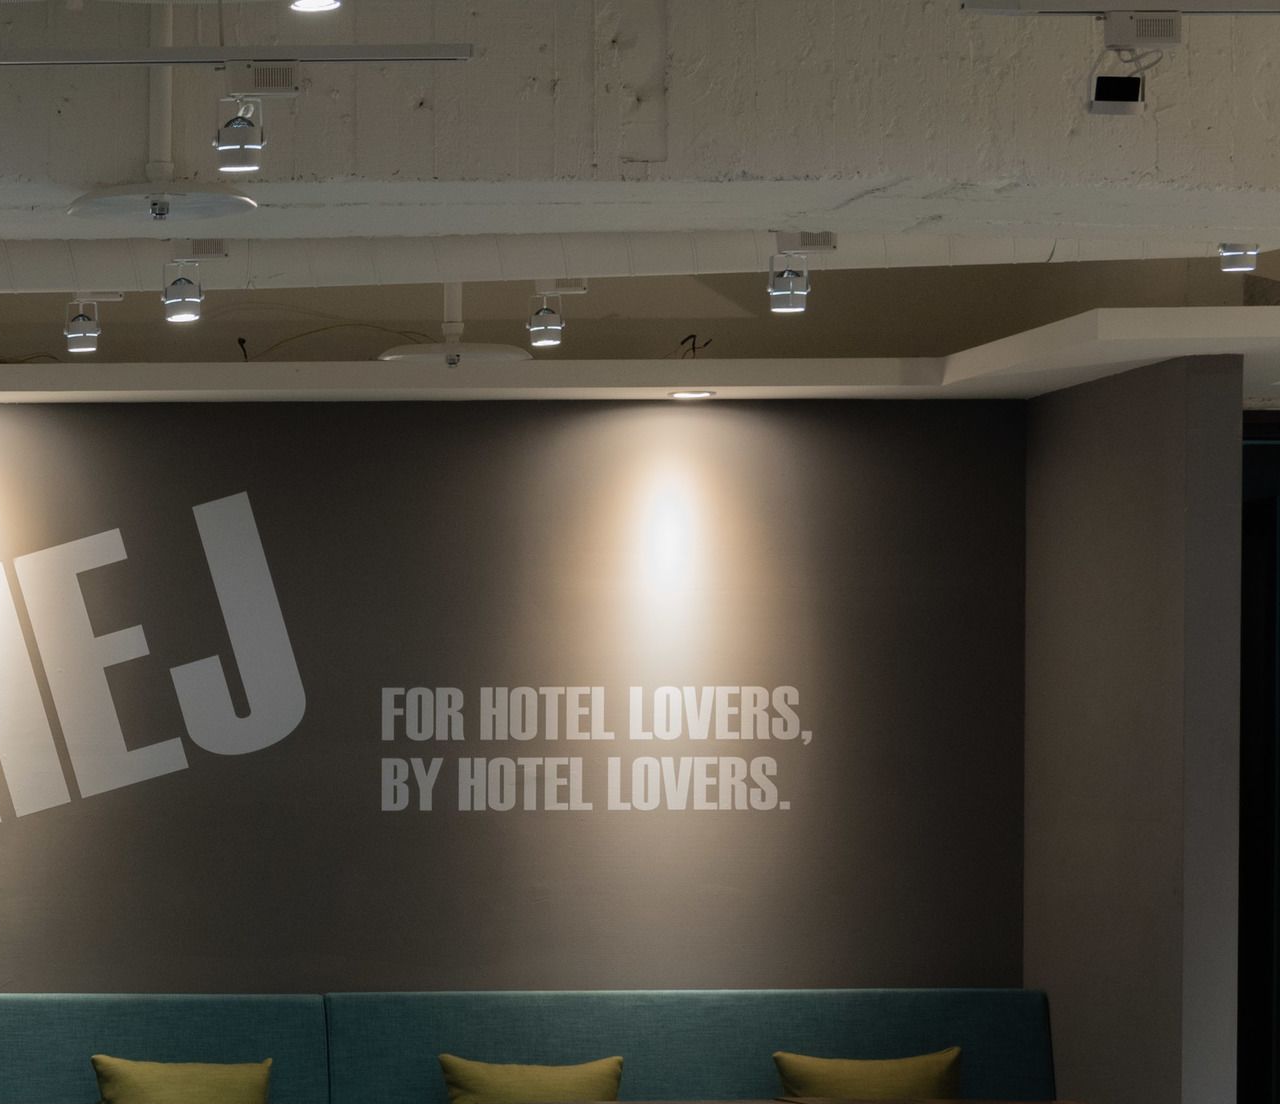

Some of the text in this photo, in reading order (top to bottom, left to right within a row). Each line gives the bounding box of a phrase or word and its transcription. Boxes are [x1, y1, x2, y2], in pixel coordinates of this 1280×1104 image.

[382, 686, 813, 745] FOR HOTEL LOVERS,
[381, 757, 791, 811] BY HOTEL LOVERS.
